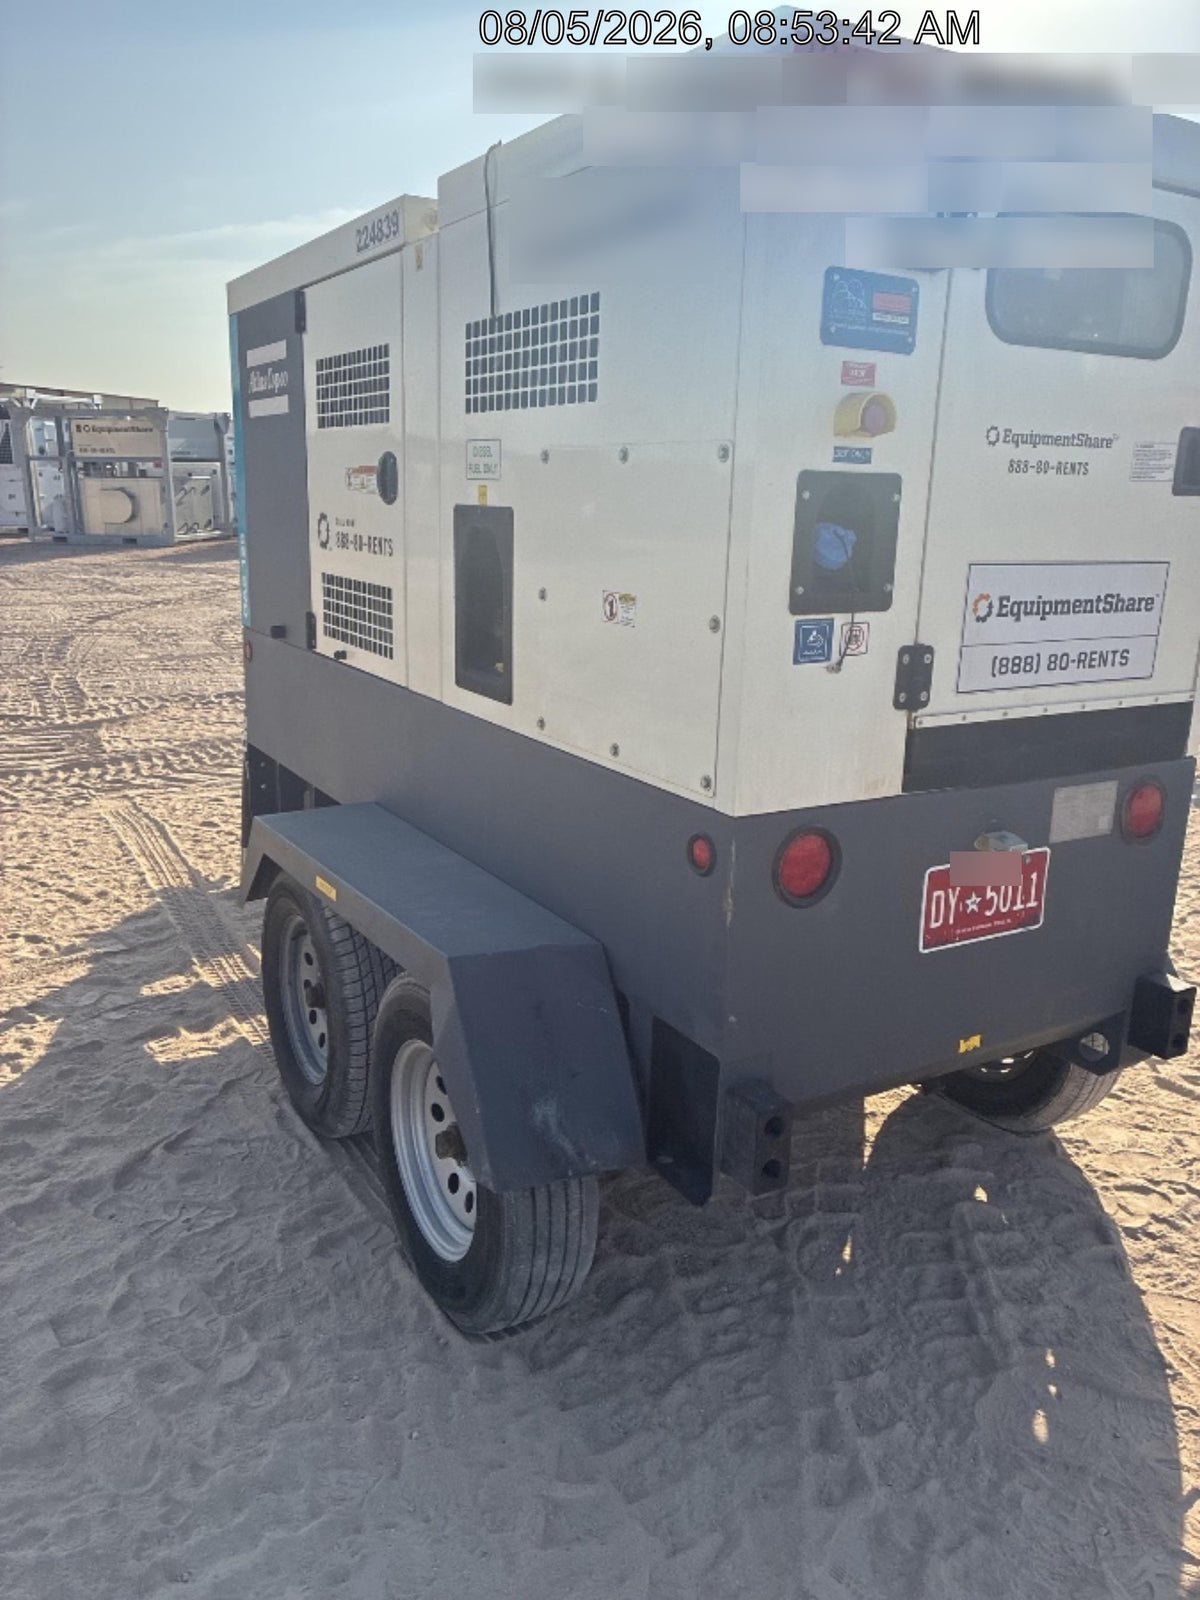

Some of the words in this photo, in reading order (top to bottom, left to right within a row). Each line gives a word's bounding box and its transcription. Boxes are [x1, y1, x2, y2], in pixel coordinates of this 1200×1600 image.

[355, 208, 399, 253] 224839
[1002, 427, 1114, 449] EquipmentShare
[1007, 458, 1090, 476] 888-80-RENTS
[995, 593, 1155, 622] EquipmentShare
[991, 653, 1041, 678] (888)
[1047, 649, 1130, 671] 80-RENTS
[930, 886, 960, 929] DY
